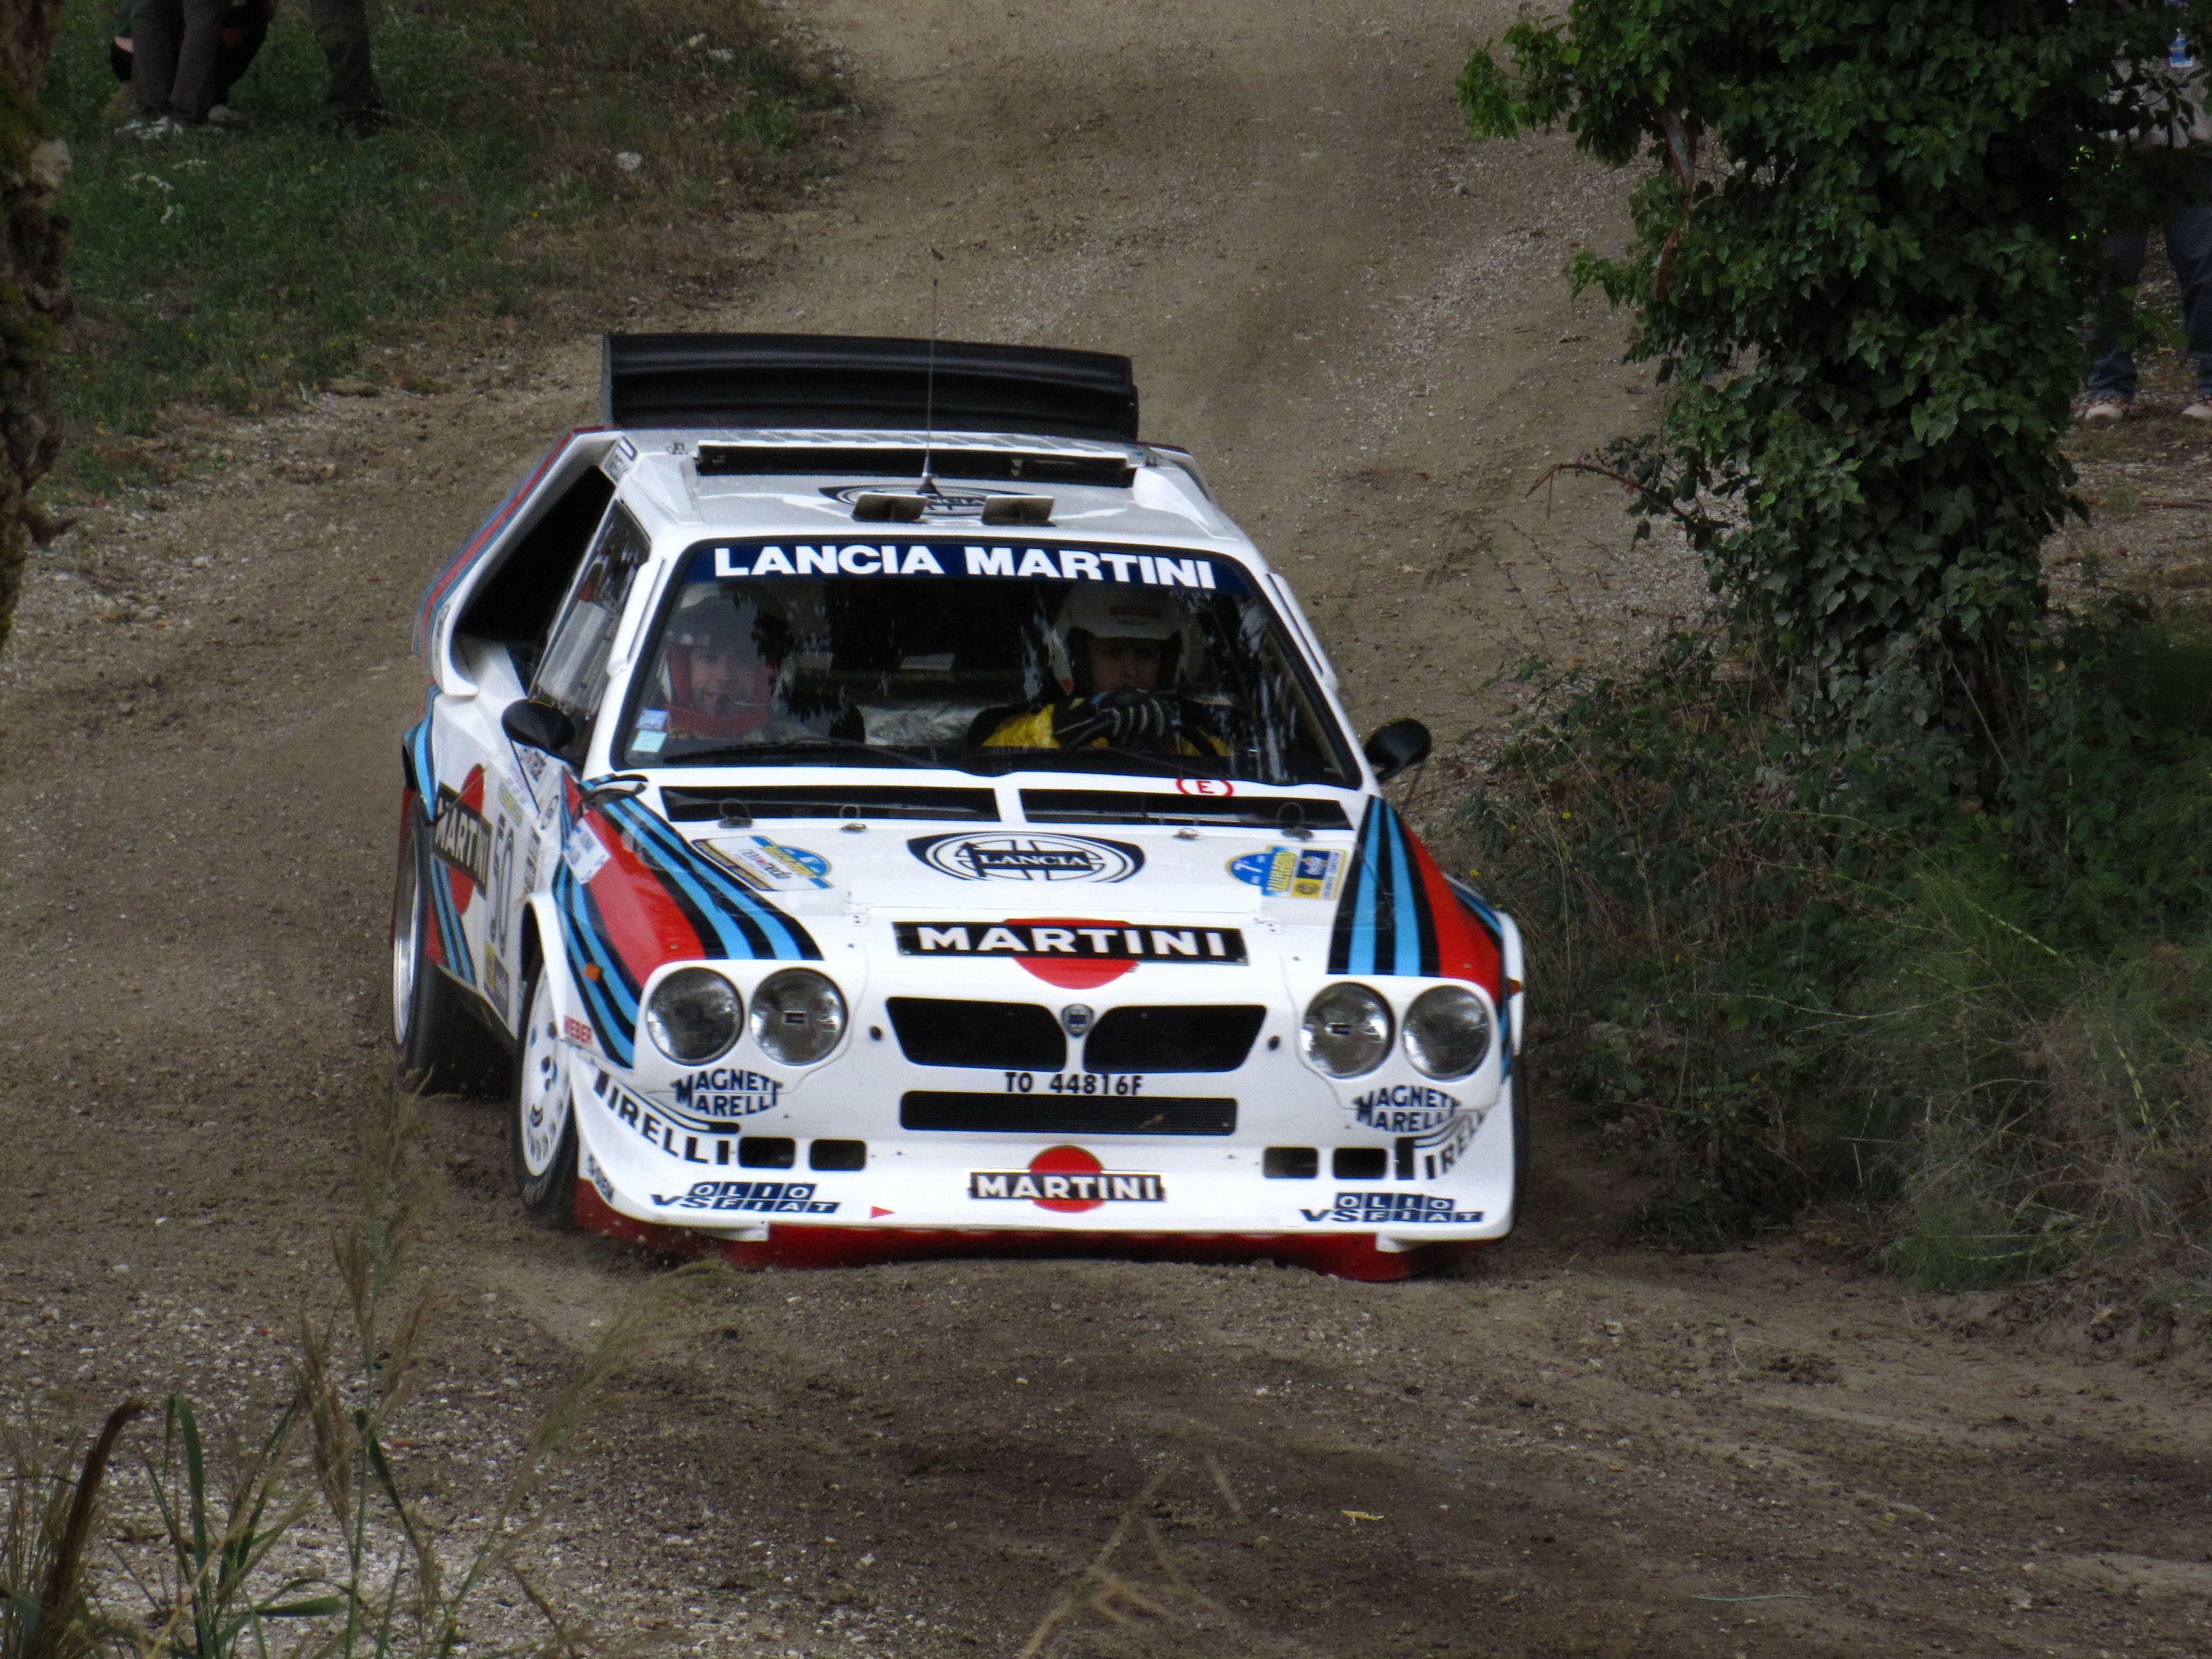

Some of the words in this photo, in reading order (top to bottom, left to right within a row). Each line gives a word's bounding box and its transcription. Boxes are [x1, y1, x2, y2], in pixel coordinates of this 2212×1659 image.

[714, 544, 946, 577] LANCIA
[964, 545, 1217, 589] MARTINI
[1195, 779, 1215, 794] E
[979, 852, 1088, 866] LANCIA
[916, 925, 1226, 957] MARTINI
[1005, 1071, 1033, 1093] TO
[1050, 1073, 1143, 1096] 44816F
[692, 1183, 812, 1201] OLIO
[977, 1176, 1159, 1200] MARTINI
[1337, 1194, 1452, 1211] OLIO
